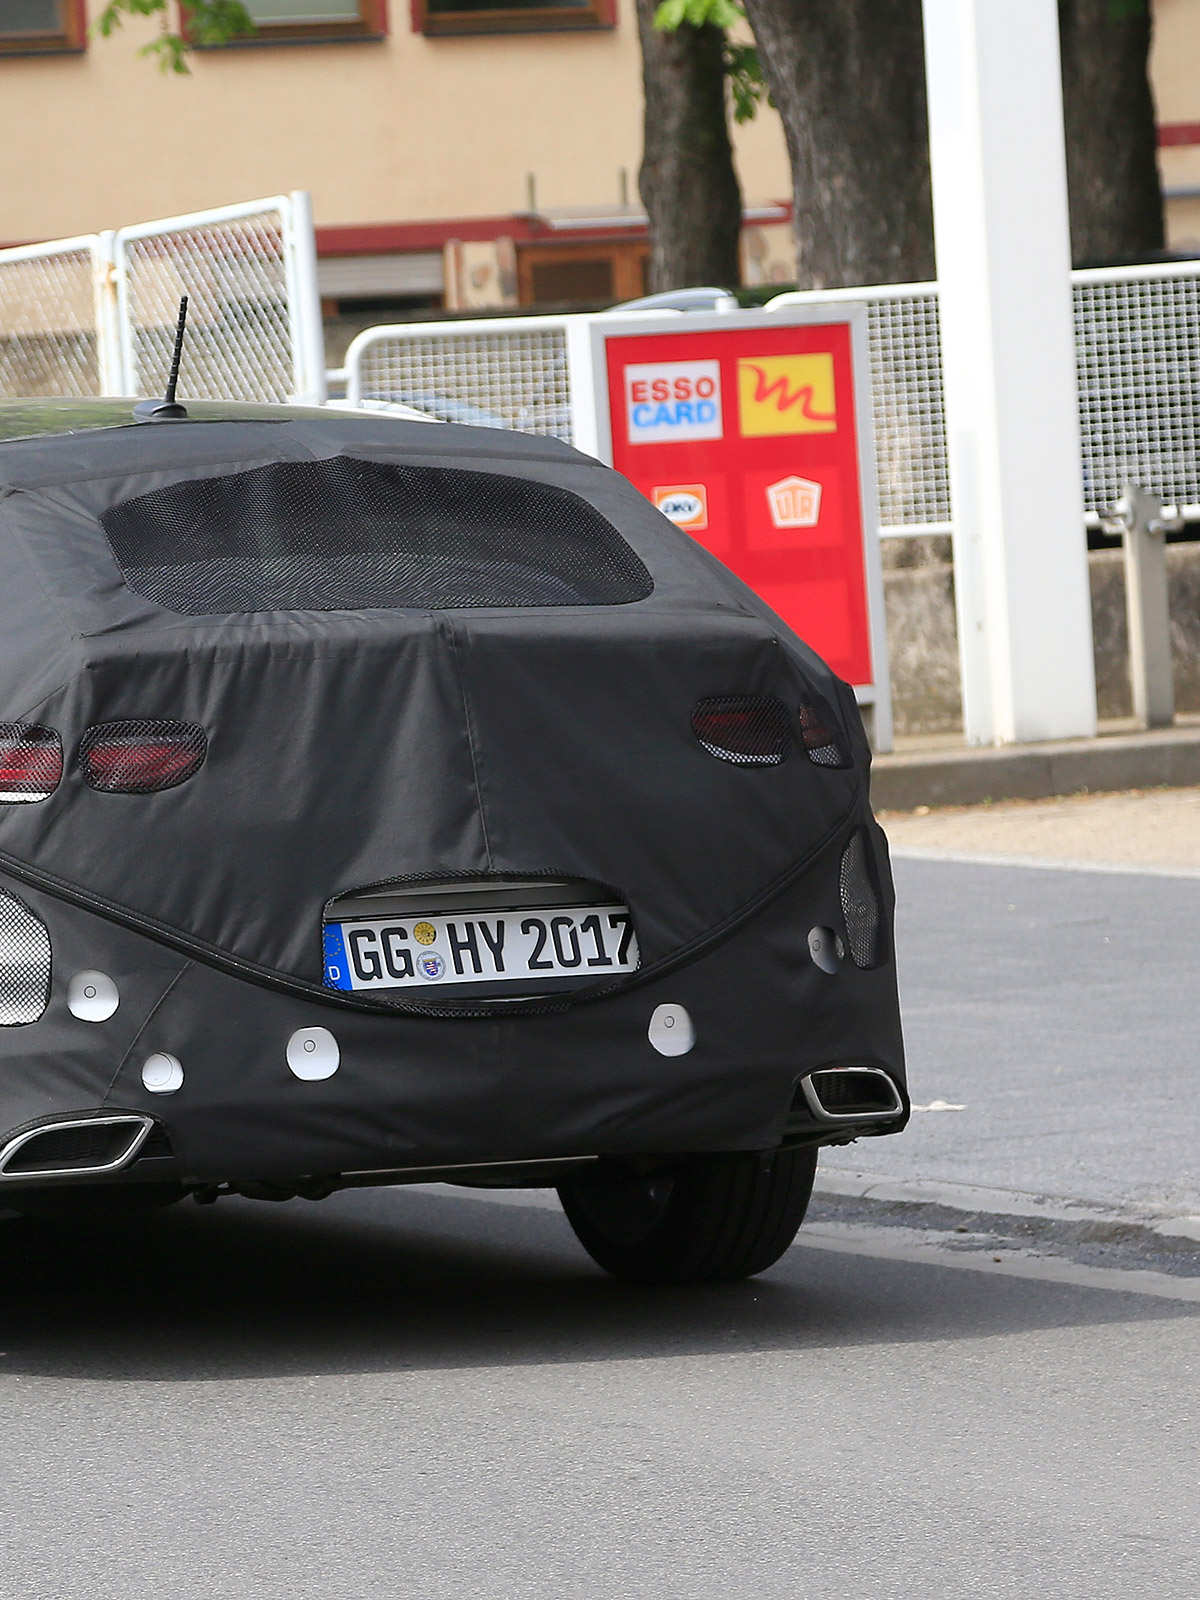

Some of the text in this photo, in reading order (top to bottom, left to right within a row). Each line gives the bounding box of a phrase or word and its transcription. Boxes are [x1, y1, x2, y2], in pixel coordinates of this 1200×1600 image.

[631, 375, 715, 402] ESSO
[632, 400, 717, 428] CARD
[348, 913, 635, 981] GG HY 2017
[328, 965, 341, 981] D
